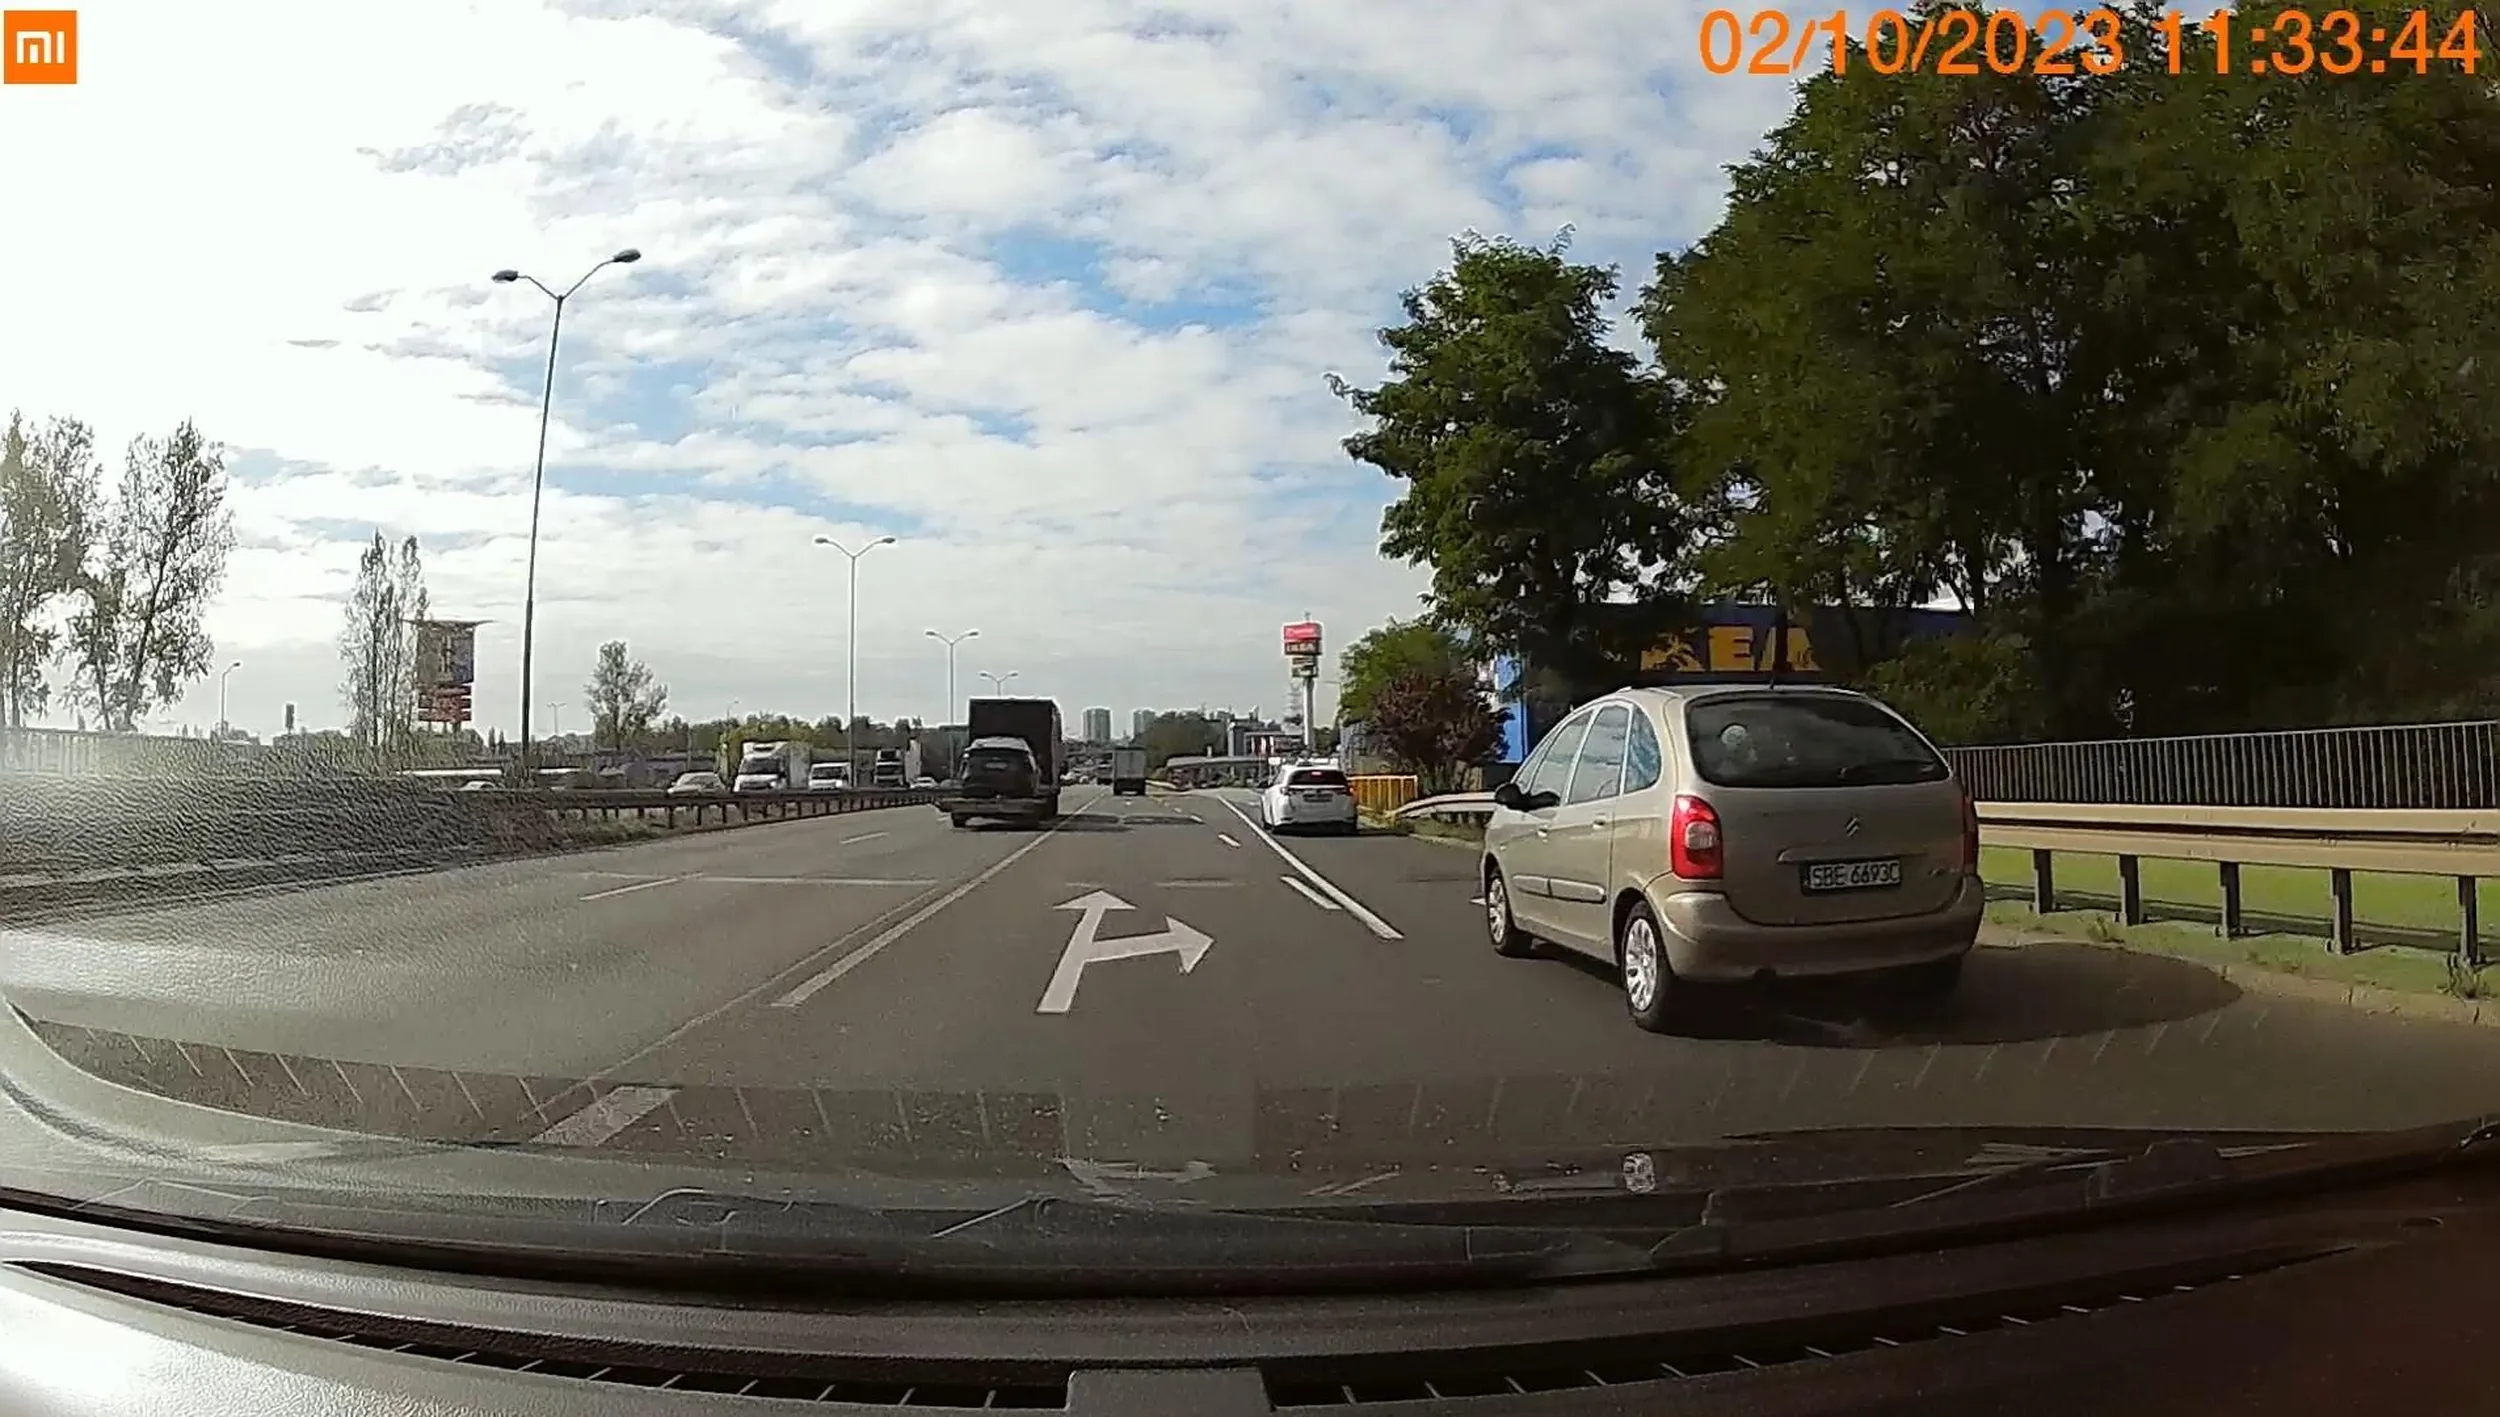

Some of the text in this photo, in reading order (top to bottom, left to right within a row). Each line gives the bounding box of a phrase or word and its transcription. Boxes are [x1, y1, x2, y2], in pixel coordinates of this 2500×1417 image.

[1640, 626, 1823, 672] KEA
[1811, 862, 1900, 888] SBE 6693C
